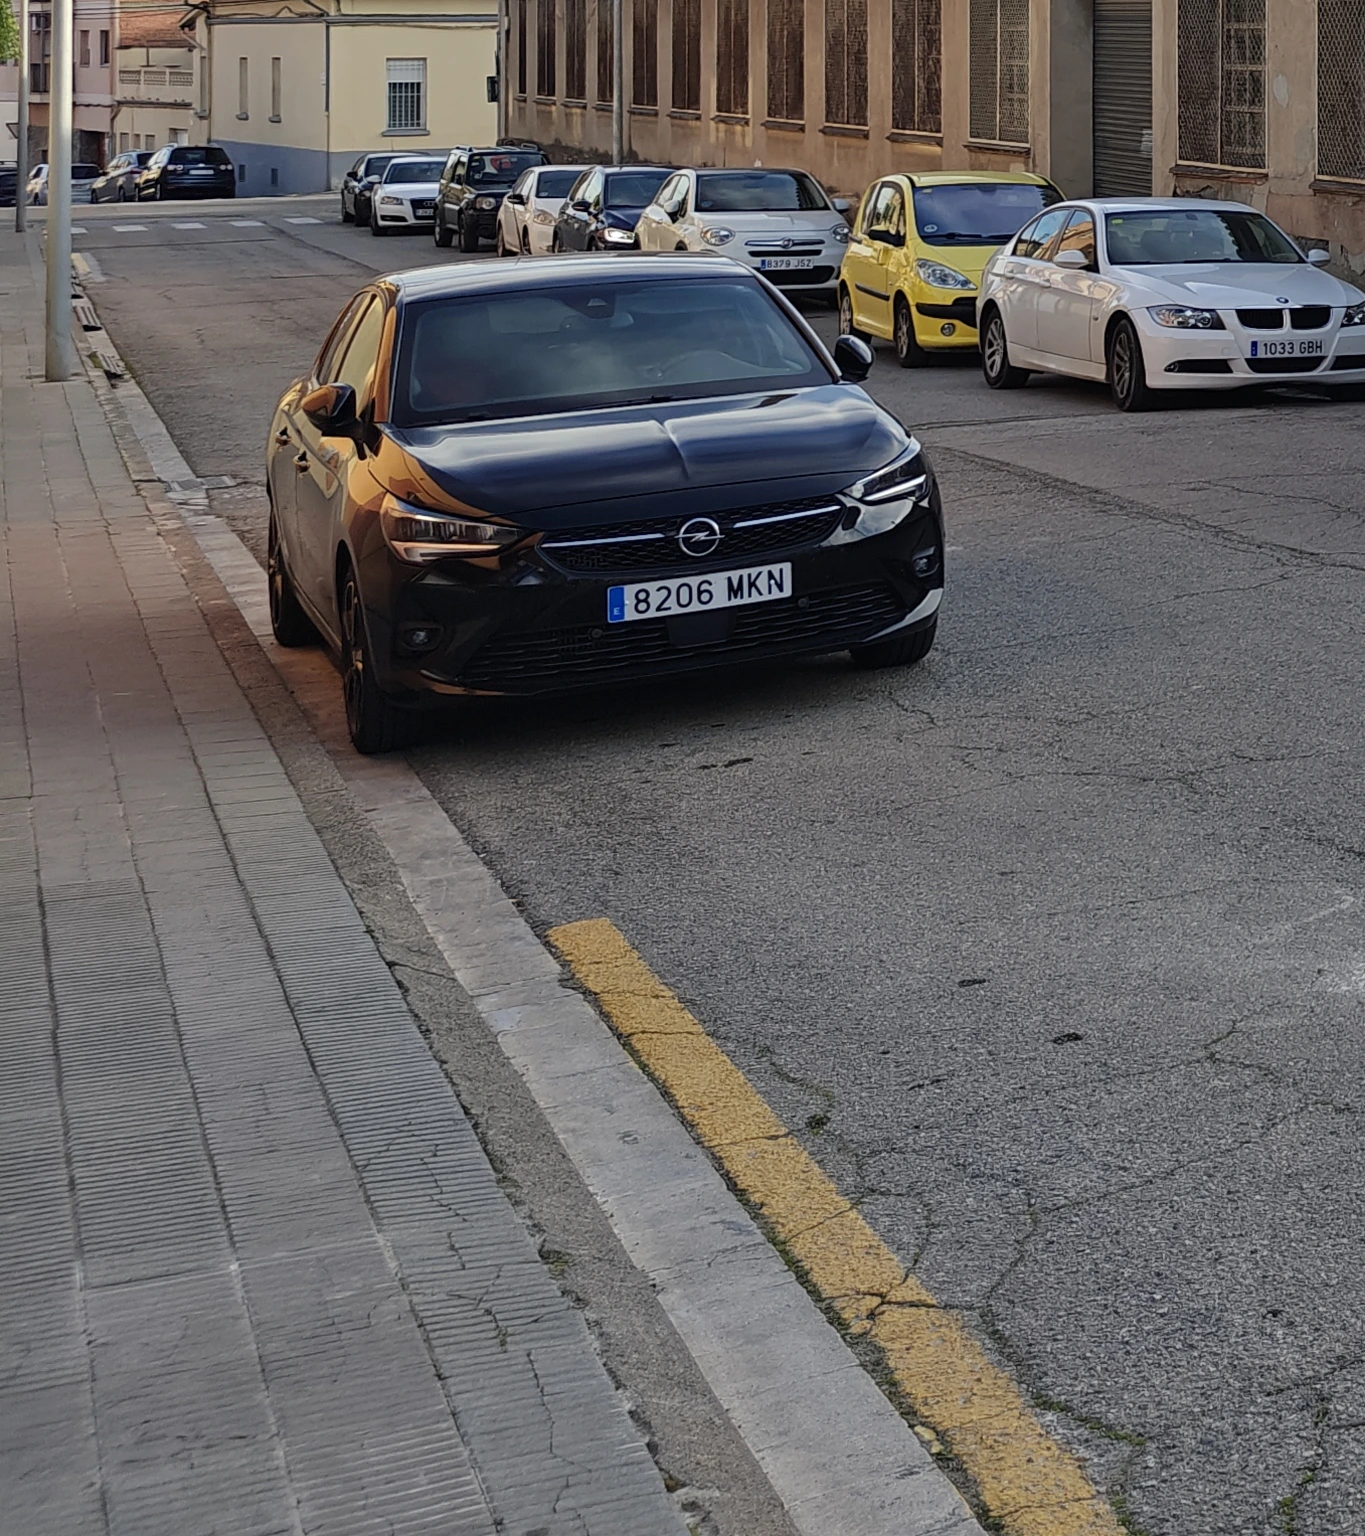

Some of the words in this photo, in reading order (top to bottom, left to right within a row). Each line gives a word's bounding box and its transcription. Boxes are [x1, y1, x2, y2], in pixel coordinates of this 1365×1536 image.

[767, 259, 791, 268] 8379
[794, 259, 812, 268] JSZ
[1263, 342, 1295, 355] 1033
[1299, 340, 1323, 354] GBH
[613, 607, 621, 615] E
[634, 579, 714, 614] 8206
[726, 568, 784, 602] MKN
